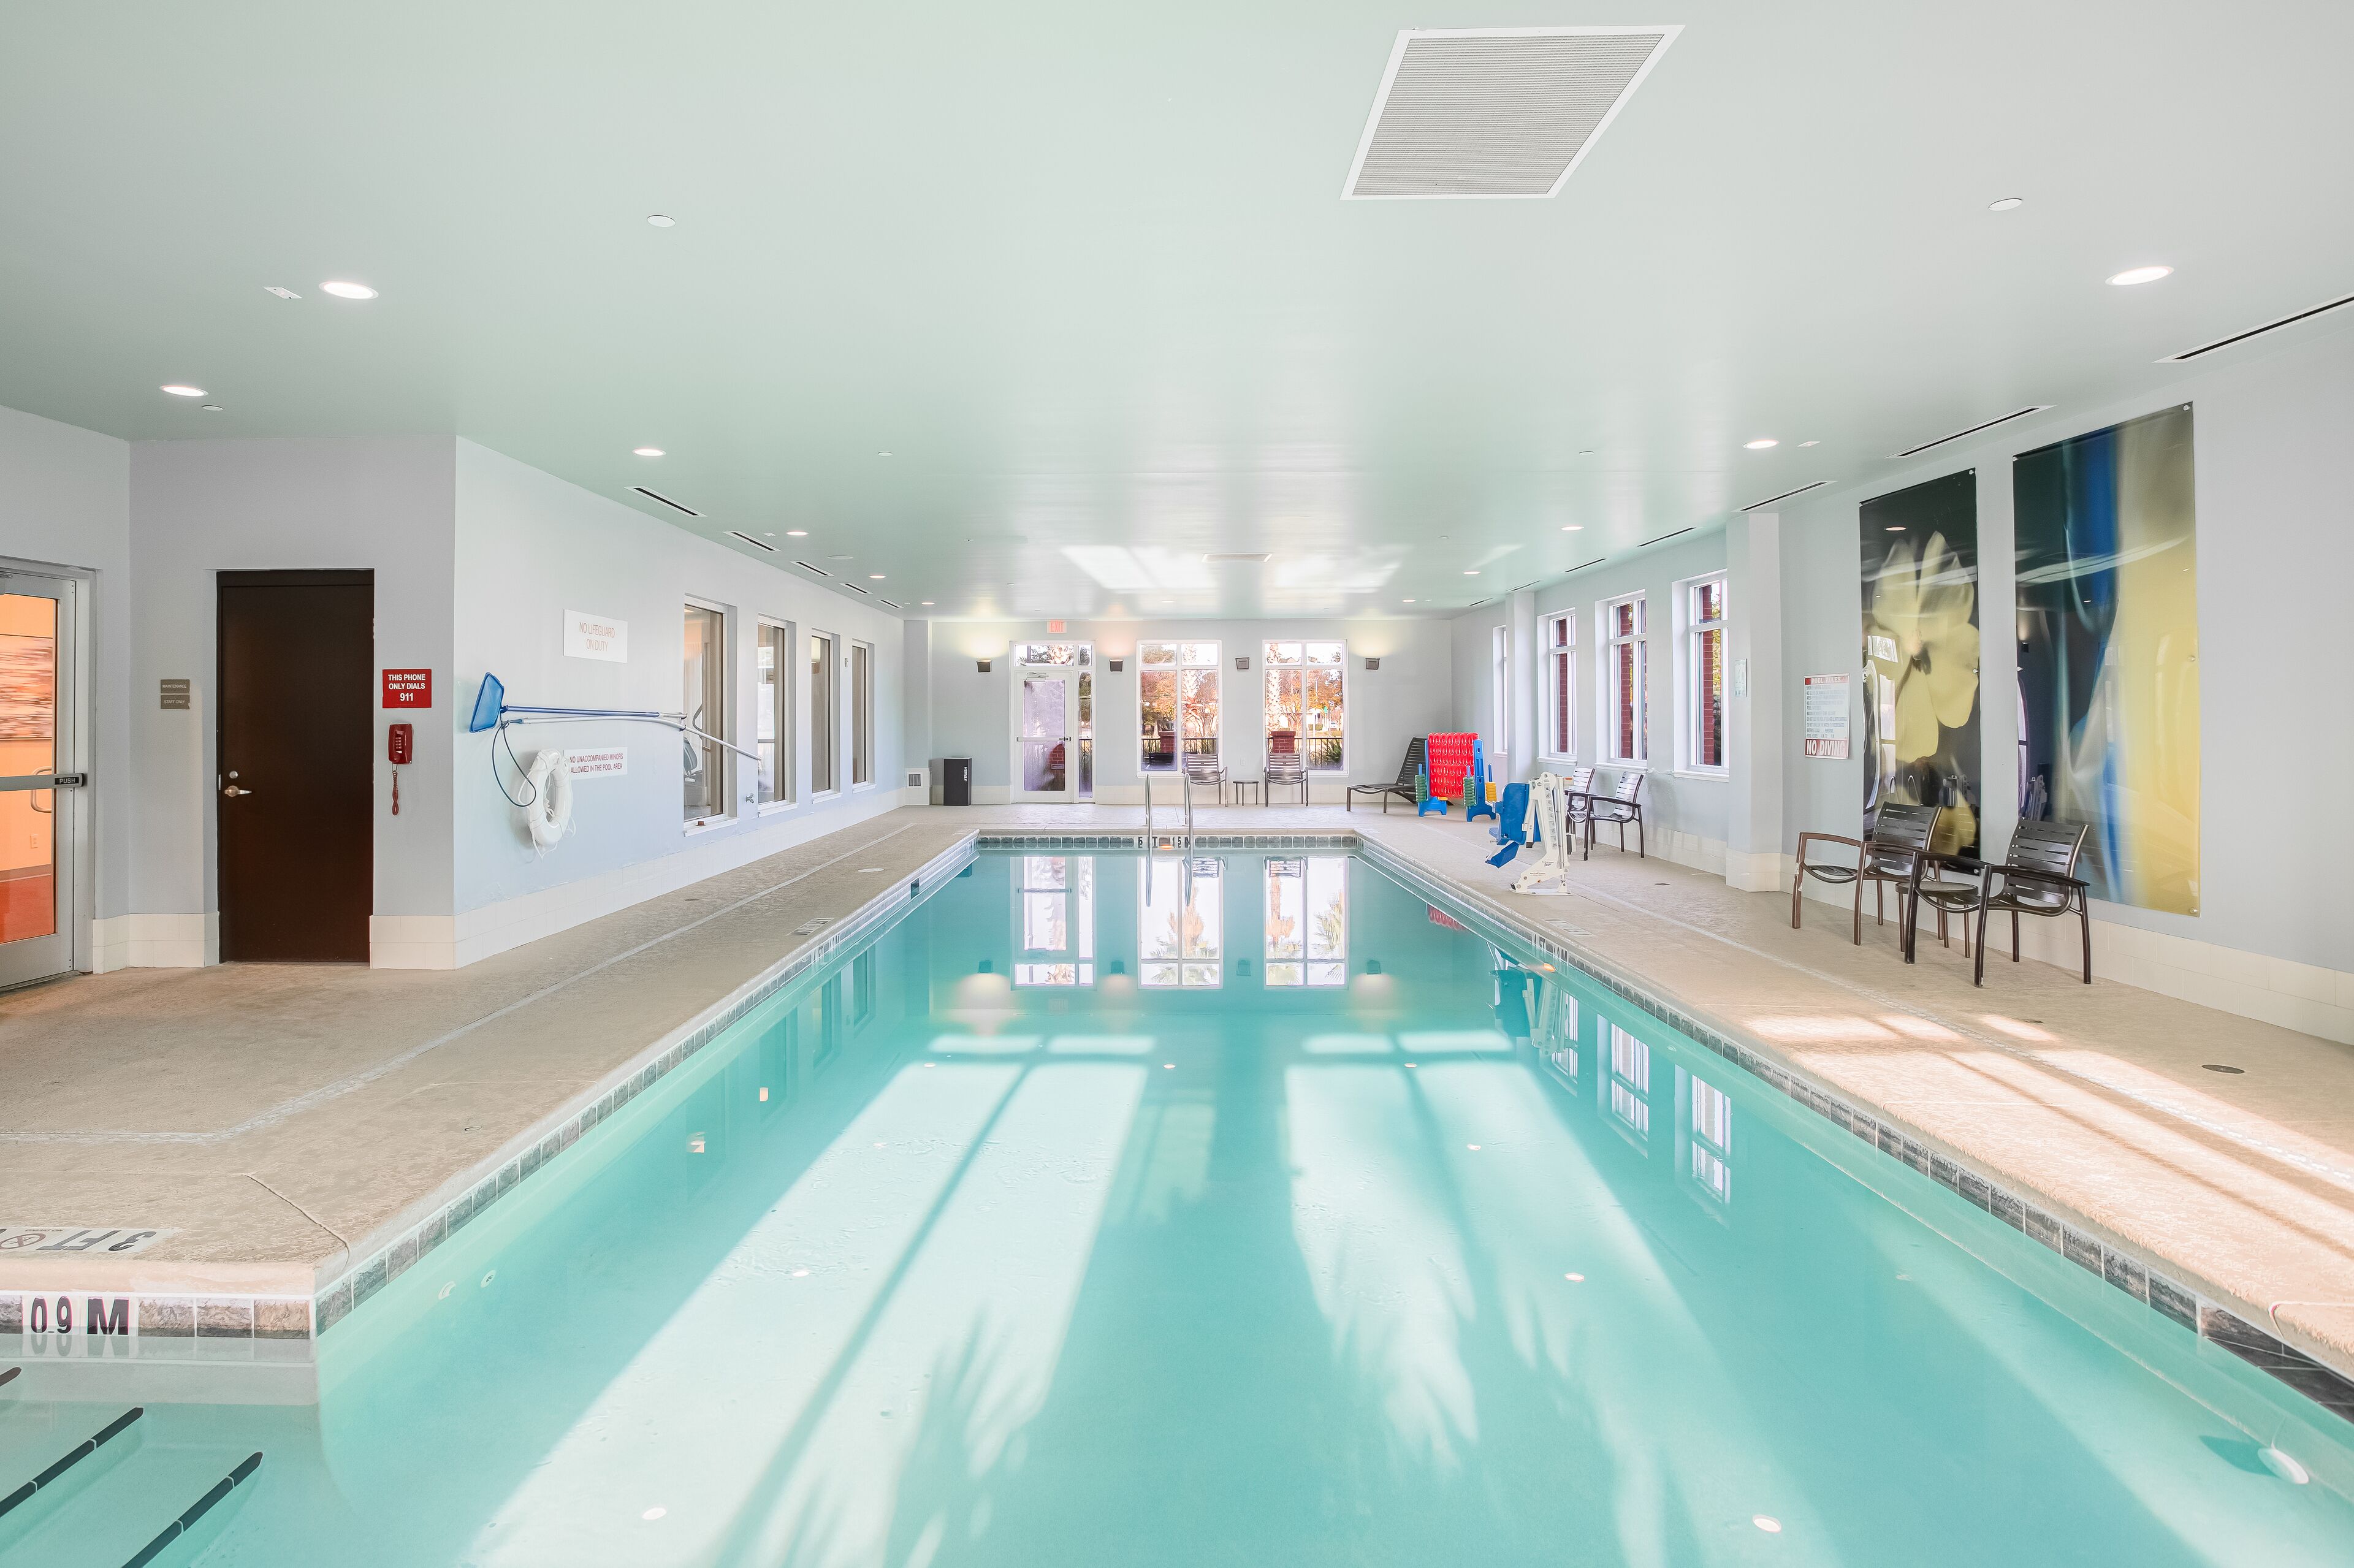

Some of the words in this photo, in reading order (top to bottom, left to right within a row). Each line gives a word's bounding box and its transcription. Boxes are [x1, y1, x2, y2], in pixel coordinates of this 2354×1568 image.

[579, 622, 587, 633] NO
[588, 623, 615, 637] LIFEGUARD
[1050, 622, 1064, 632] EXIT
[587, 639, 593, 650] ON
[595, 640, 608, 651] DUTY
[400, 693, 413, 701] 911
[1807, 740, 1817, 755] NO
[1820, 740, 1845, 756] DIVING
[36, 1230, 121, 1250] FT
[109, 1231, 157, 1252] 3
[31, 1296, 72, 1333] 0.9
[87, 1296, 129, 1335] M
